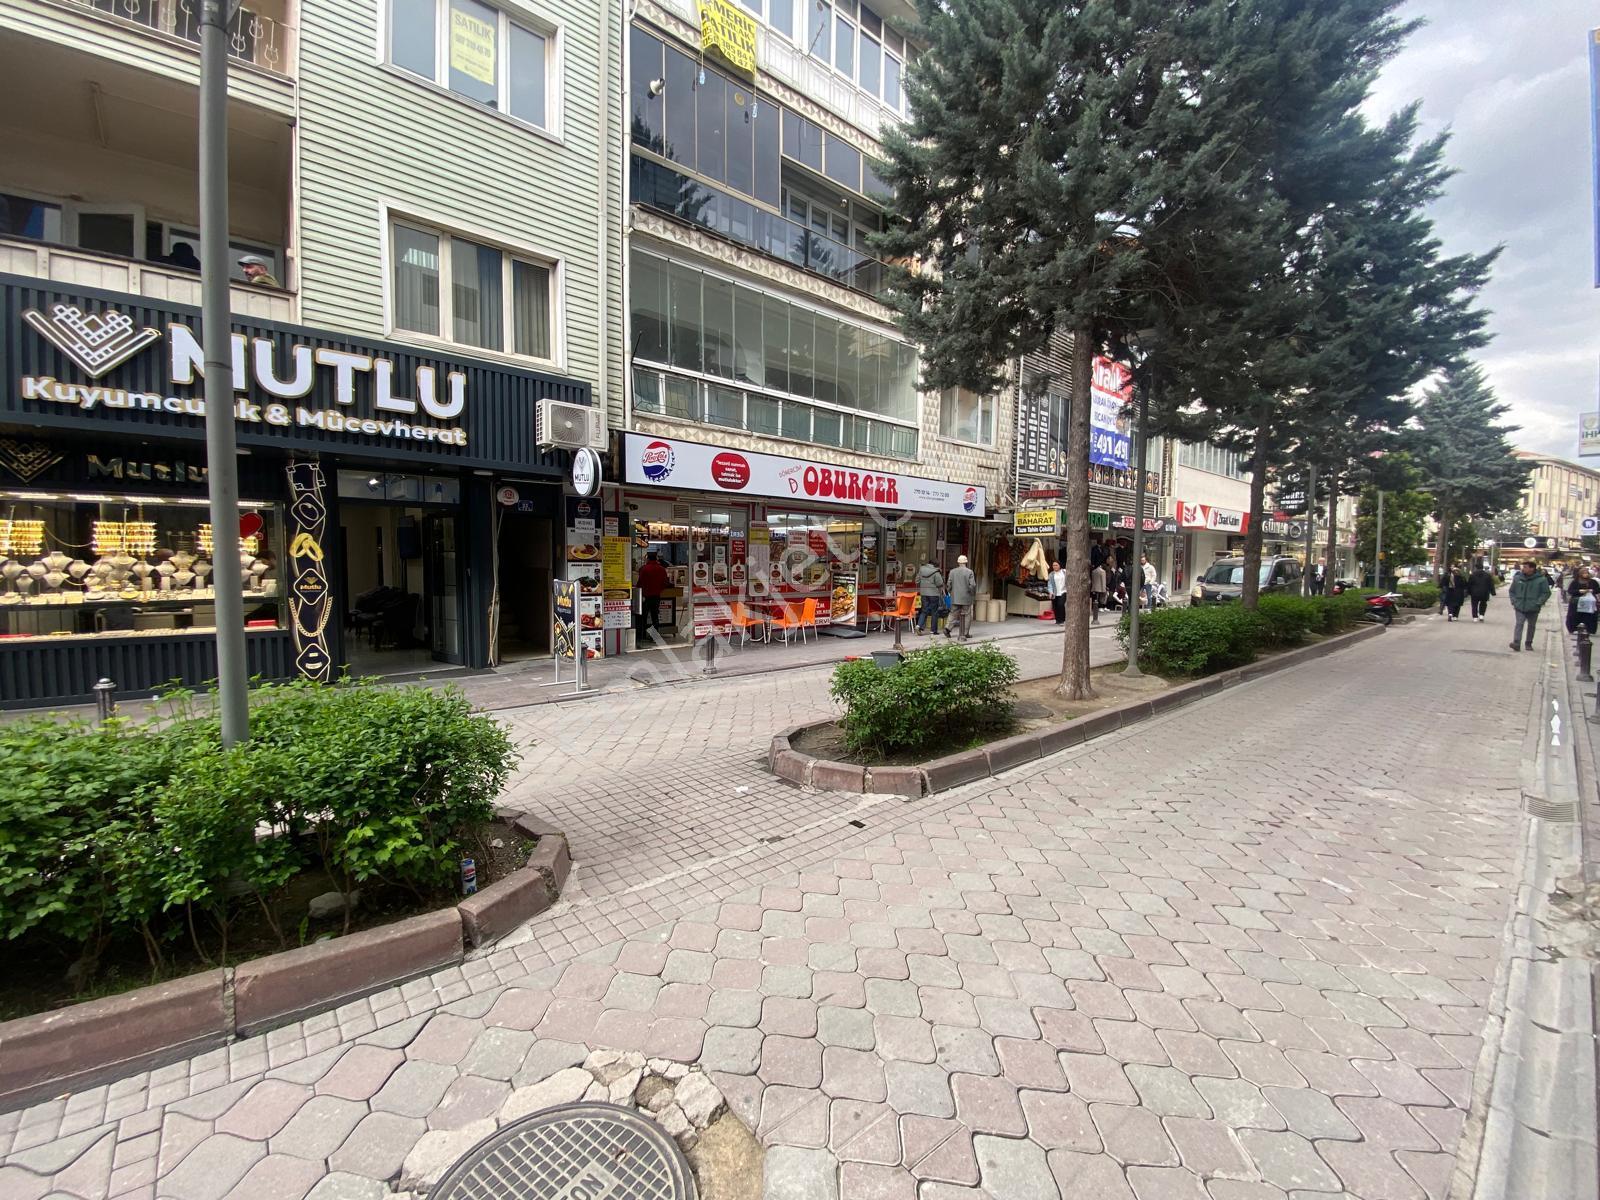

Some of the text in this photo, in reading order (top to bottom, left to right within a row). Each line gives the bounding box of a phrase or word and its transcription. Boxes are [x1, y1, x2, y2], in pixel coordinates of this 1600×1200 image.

[455, 13, 492, 41] SATILIK
[169, 321, 467, 420] MUTLU
[22, 374, 468, 447] Kuyumcuk & Mücevherat
[86, 454, 209, 483] Mutlu
[575, 474, 590, 482] MUTLU
[803, 465, 899, 505] OBURGER
[1017, 516, 1052, 525] BAHARAT
